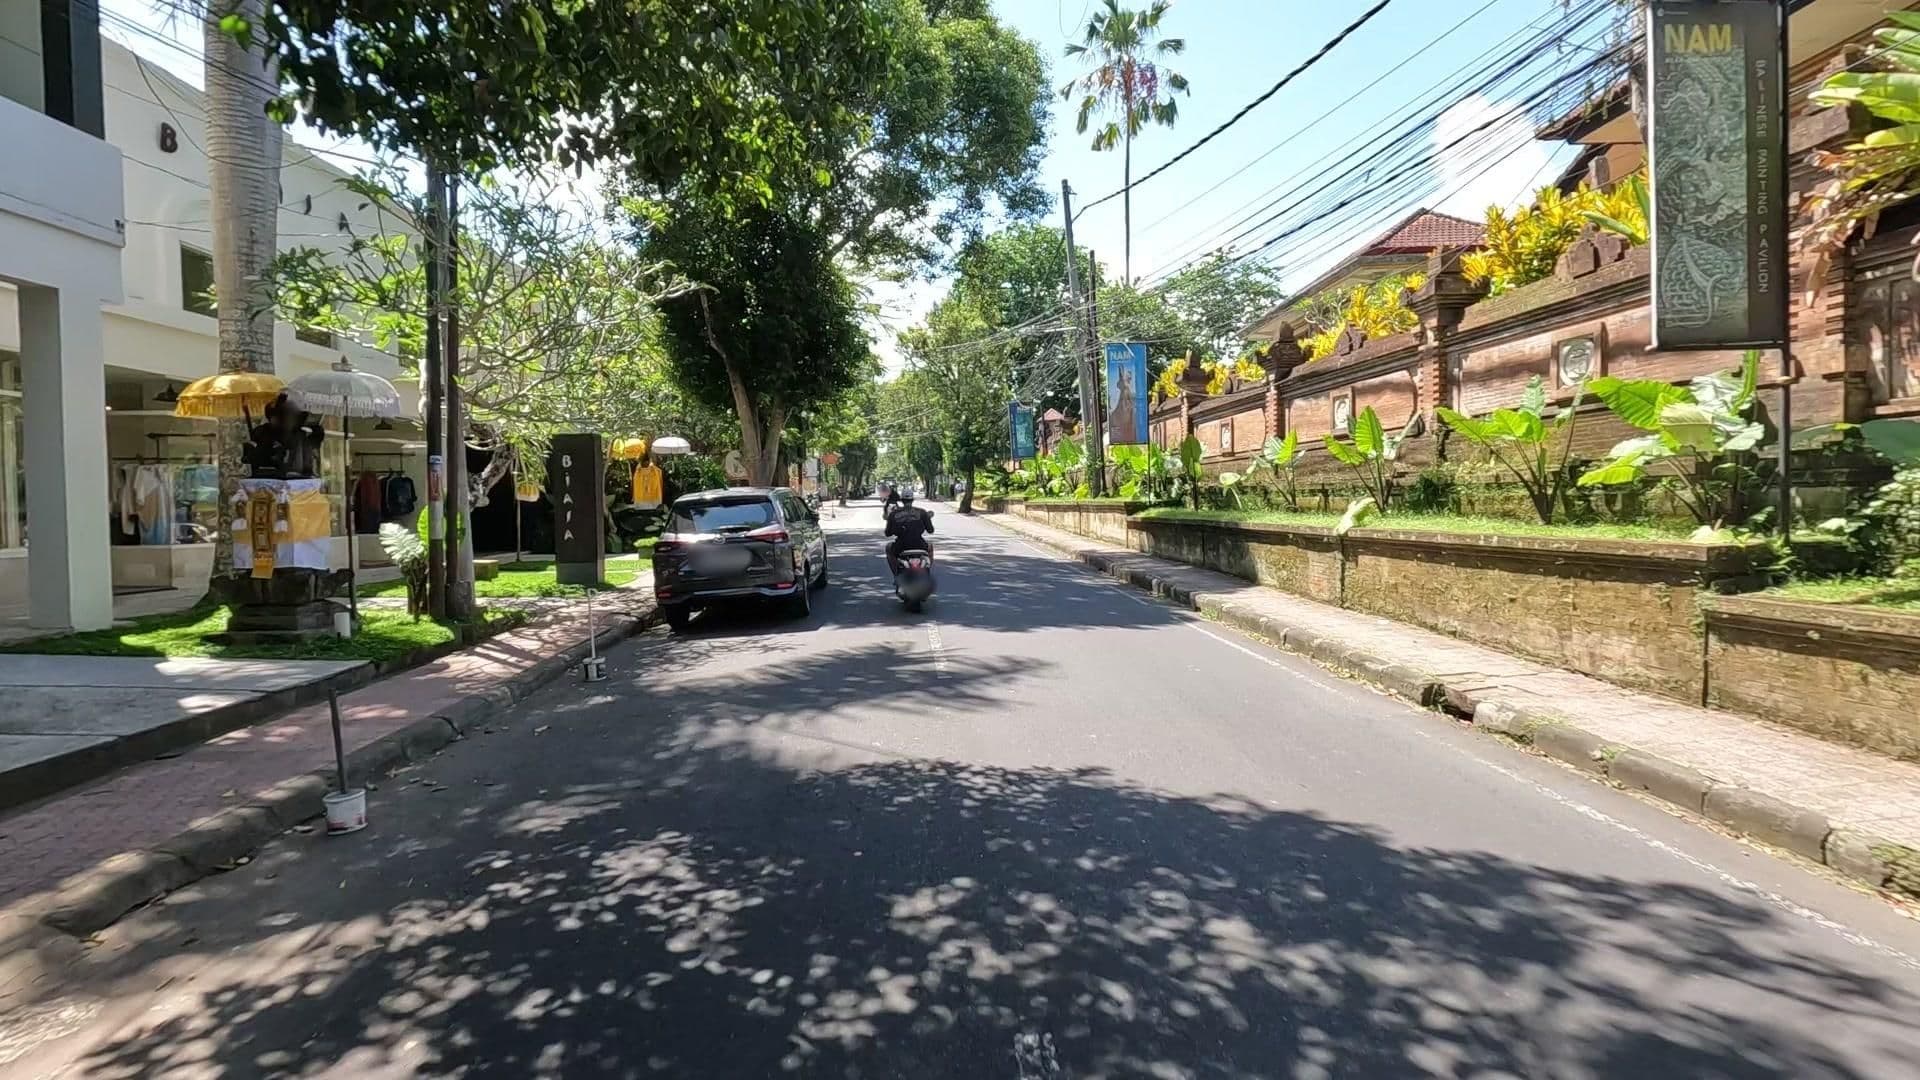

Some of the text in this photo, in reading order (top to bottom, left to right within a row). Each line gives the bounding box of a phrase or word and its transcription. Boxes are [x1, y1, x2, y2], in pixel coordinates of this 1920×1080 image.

[1664, 24, 1731, 53] NAM
[1755, 59, 1768, 293] BALINESE PAINTING PAVILION
